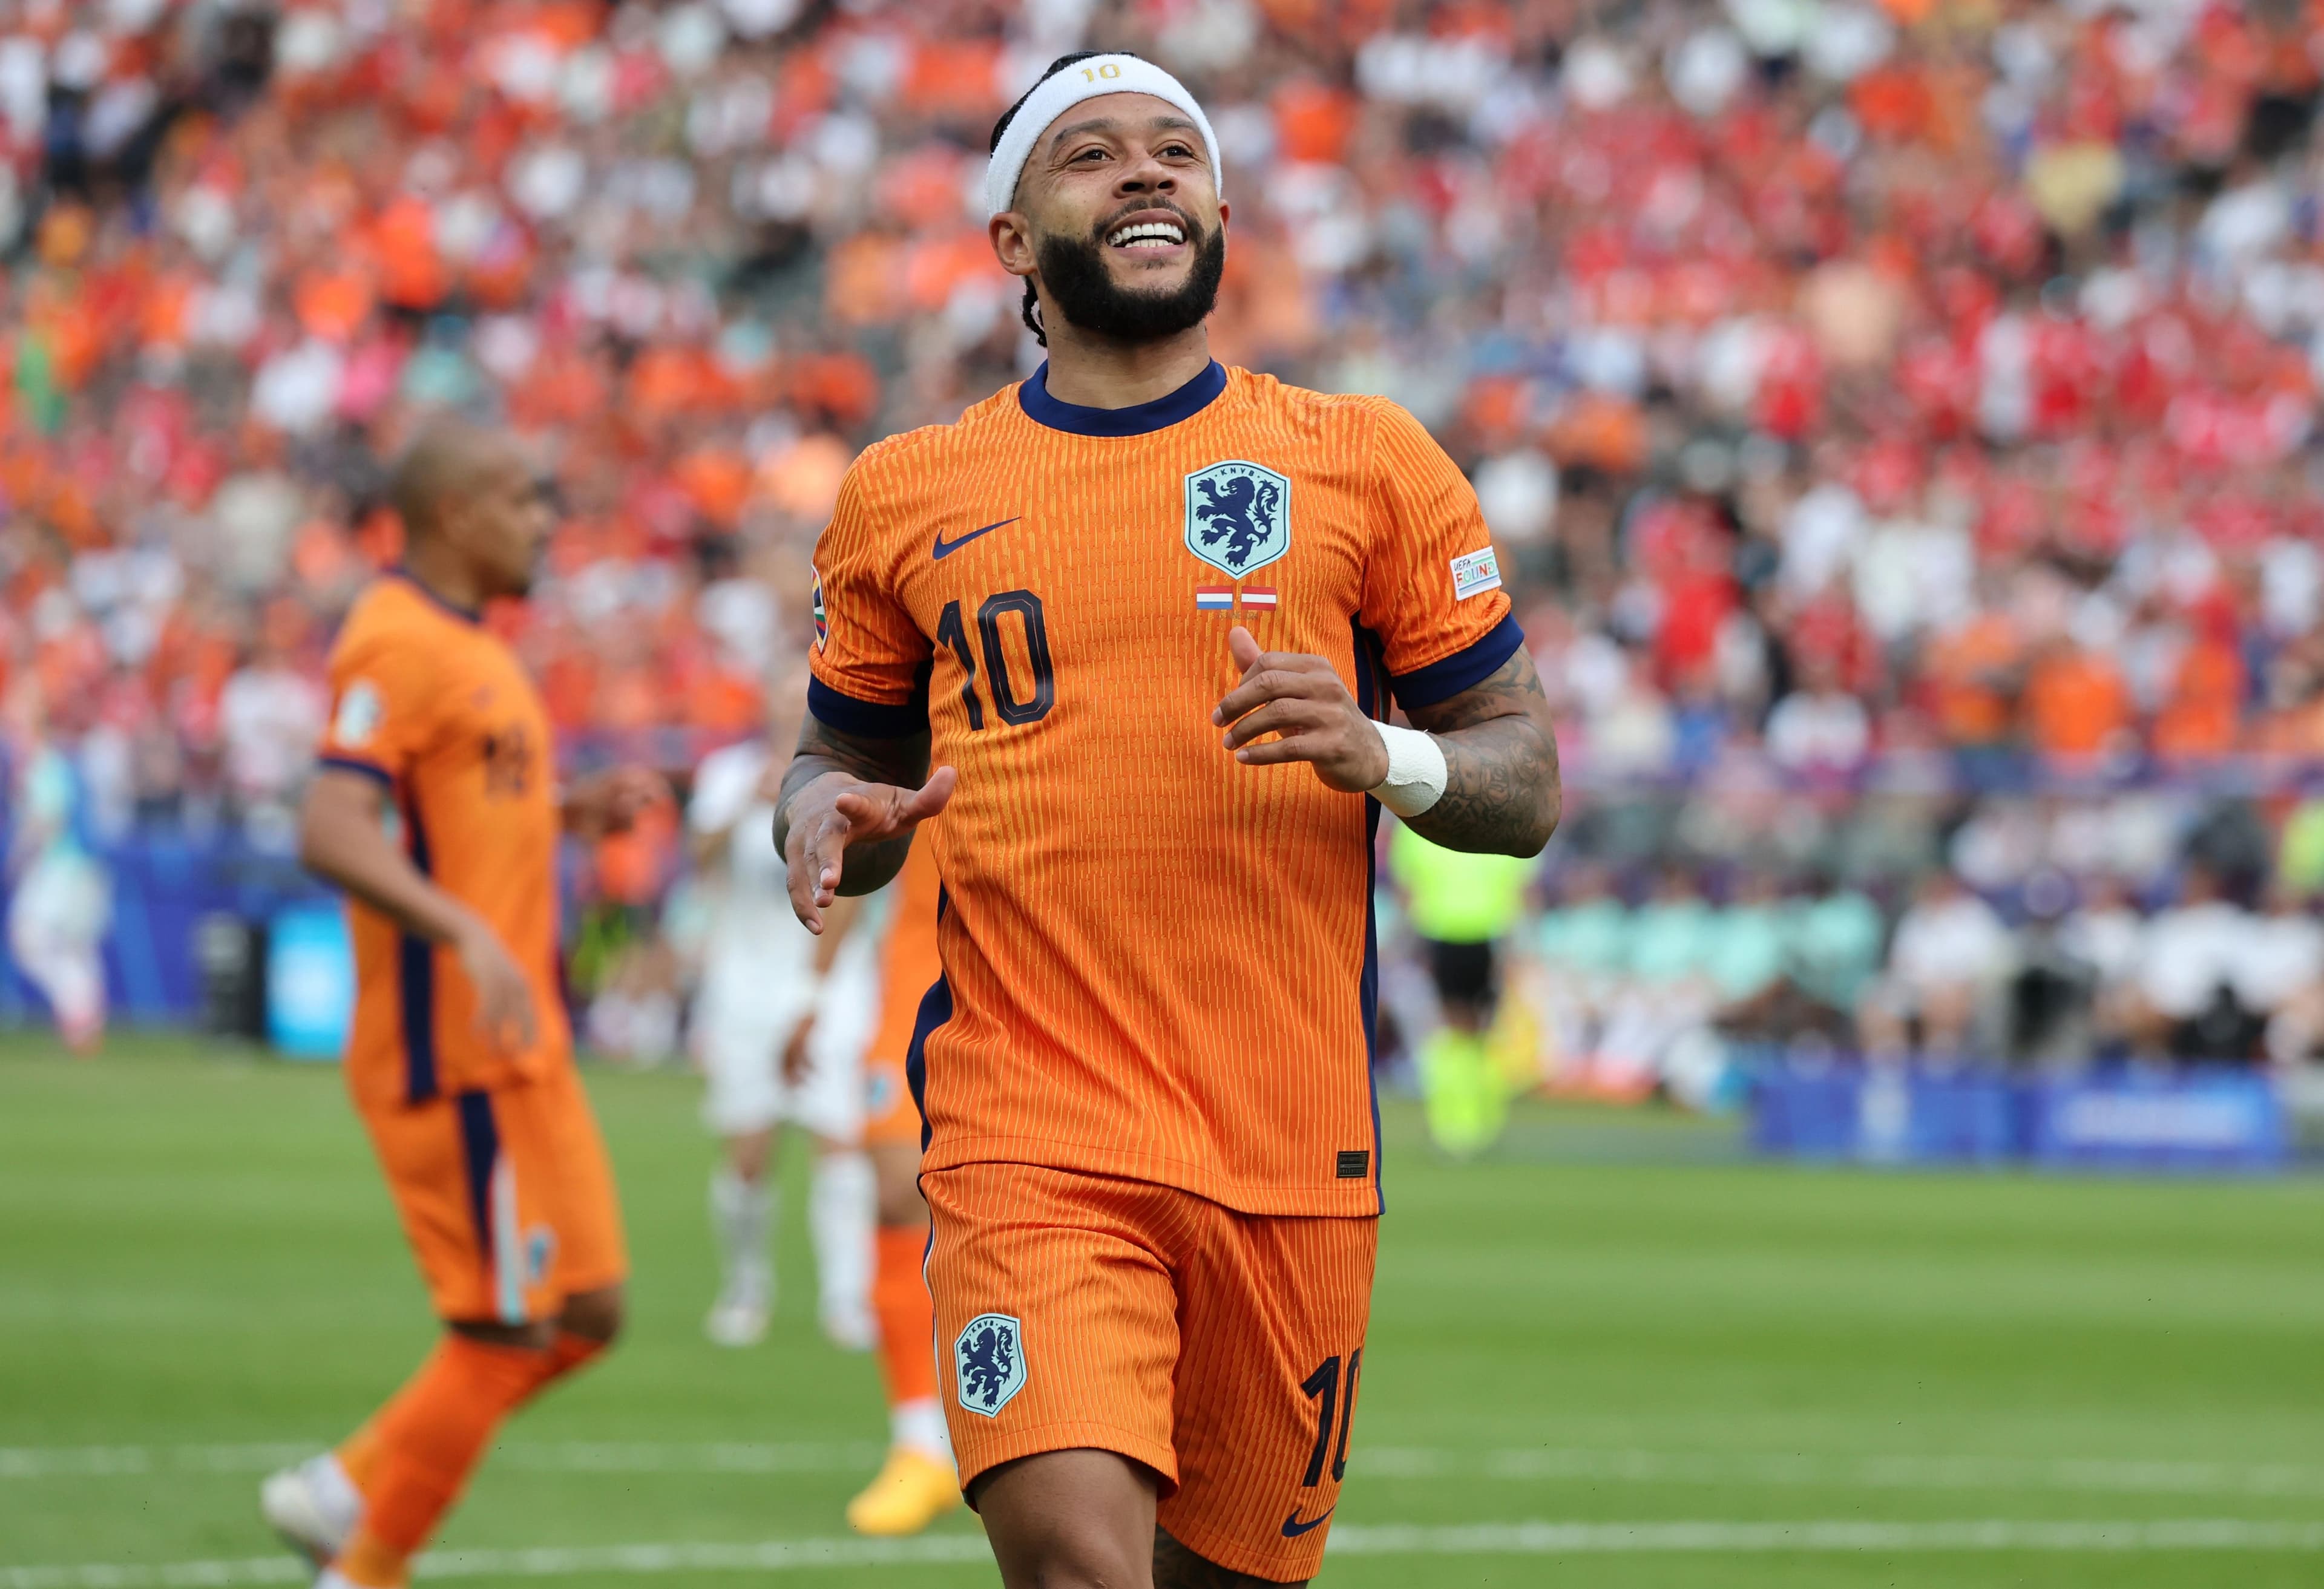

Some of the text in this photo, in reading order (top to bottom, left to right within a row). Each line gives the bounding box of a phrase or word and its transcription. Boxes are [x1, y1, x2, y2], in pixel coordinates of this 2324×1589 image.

[1081, 64, 1121, 83] 10
[1220, 467, 1255, 476] KNVB
[1454, 559, 1471, 571] UEFA
[937, 589, 1054, 732] 10
[971, 1320, 994, 1333] KNVB
